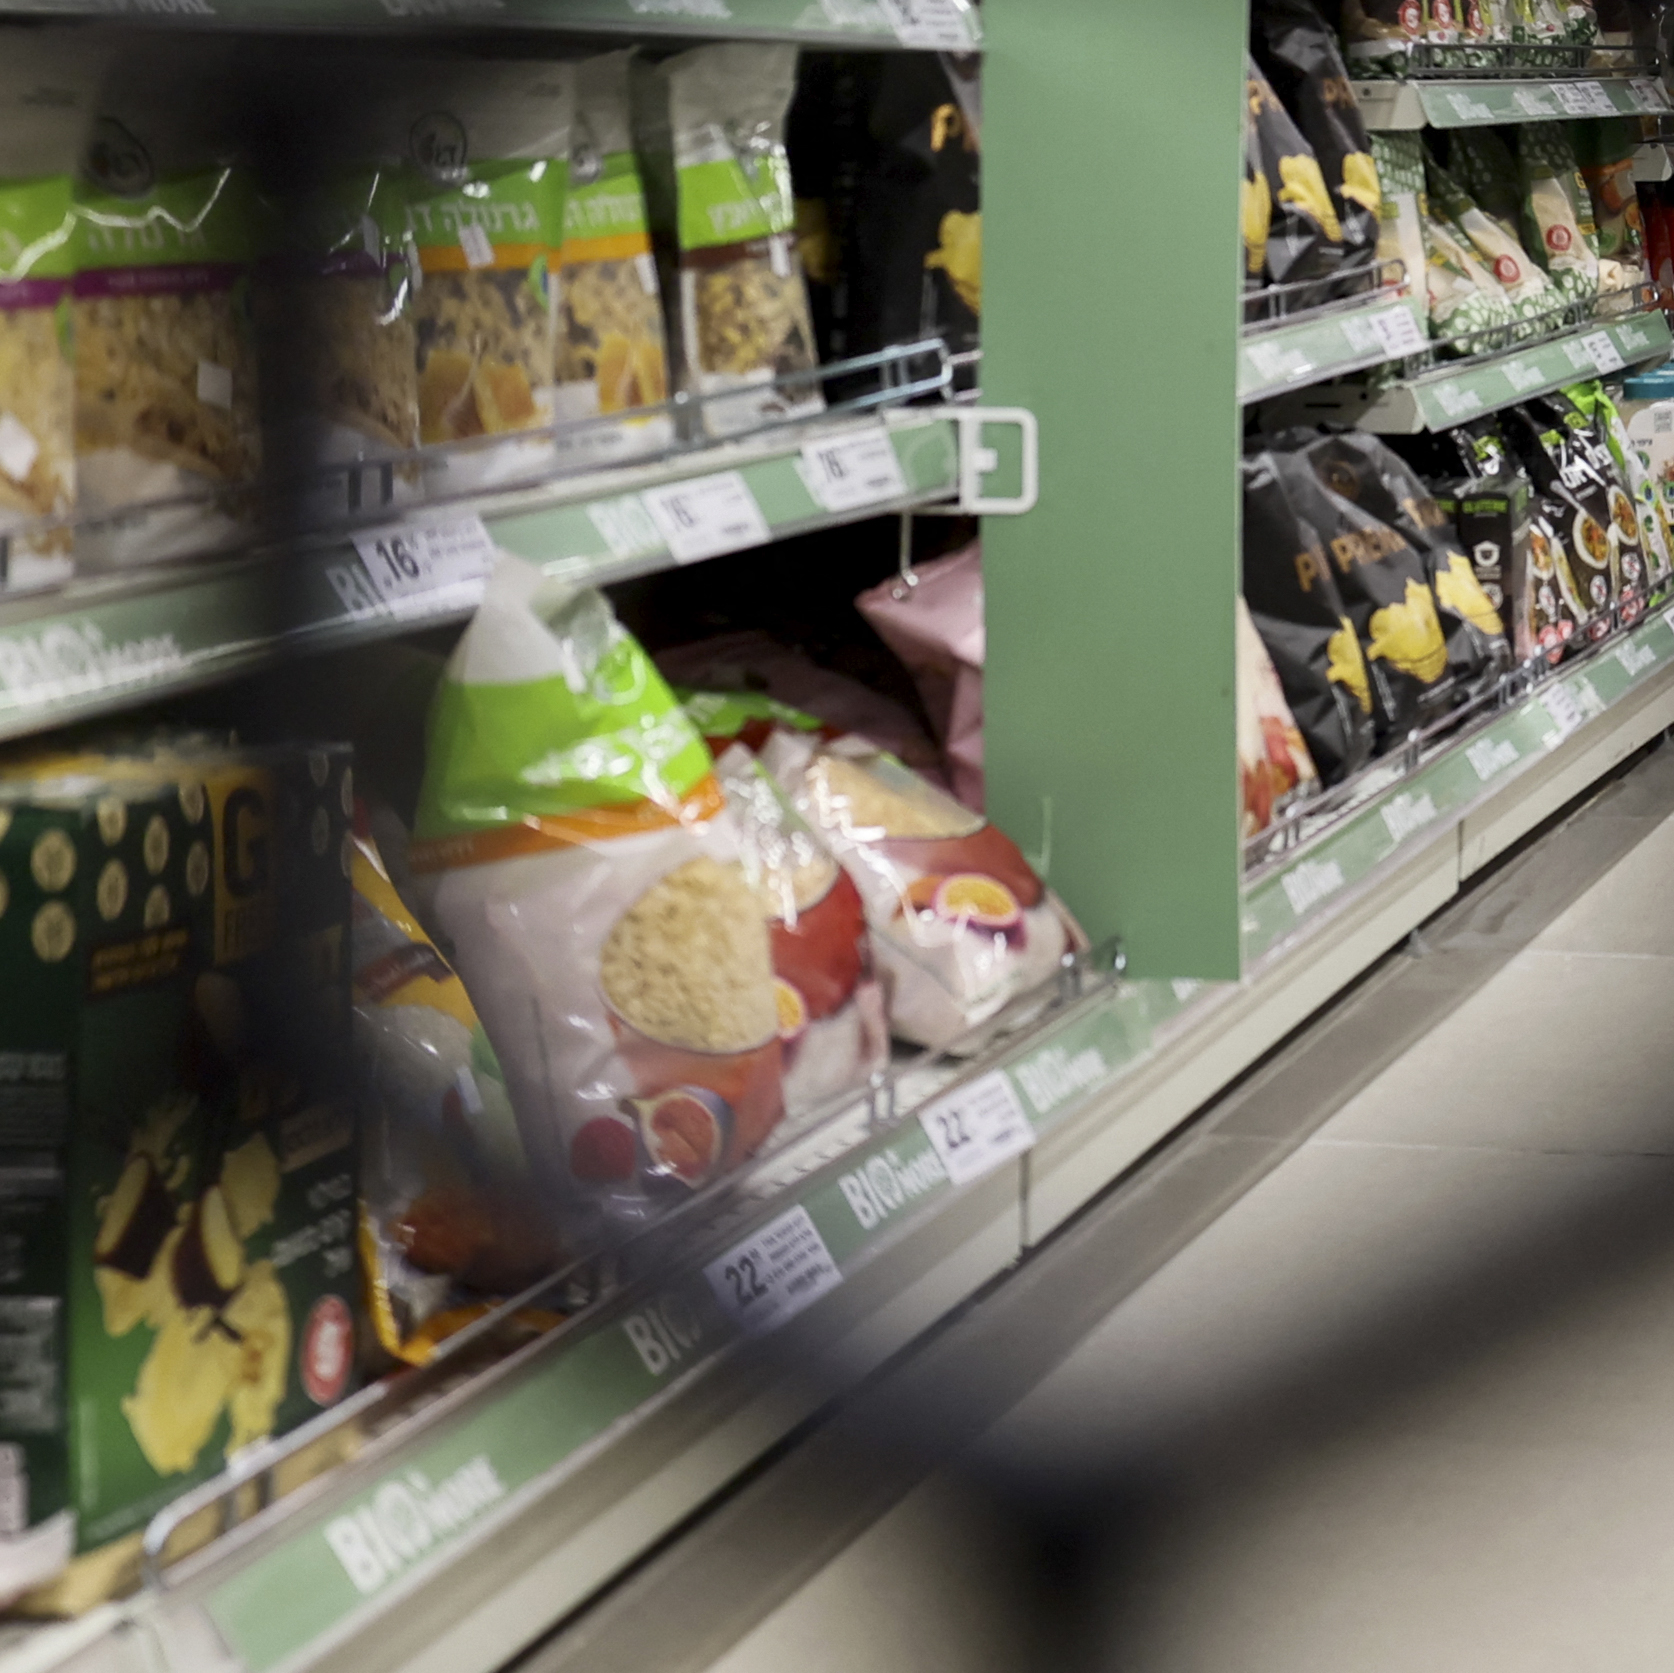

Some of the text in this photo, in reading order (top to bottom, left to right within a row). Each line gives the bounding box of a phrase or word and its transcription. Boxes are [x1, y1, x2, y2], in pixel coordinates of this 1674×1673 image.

[327, 564, 384, 619] BI
[838, 1148, 900, 1230] BIO
[723, 1254, 769, 1307] 22
[325, 1480, 432, 1594] BIO
